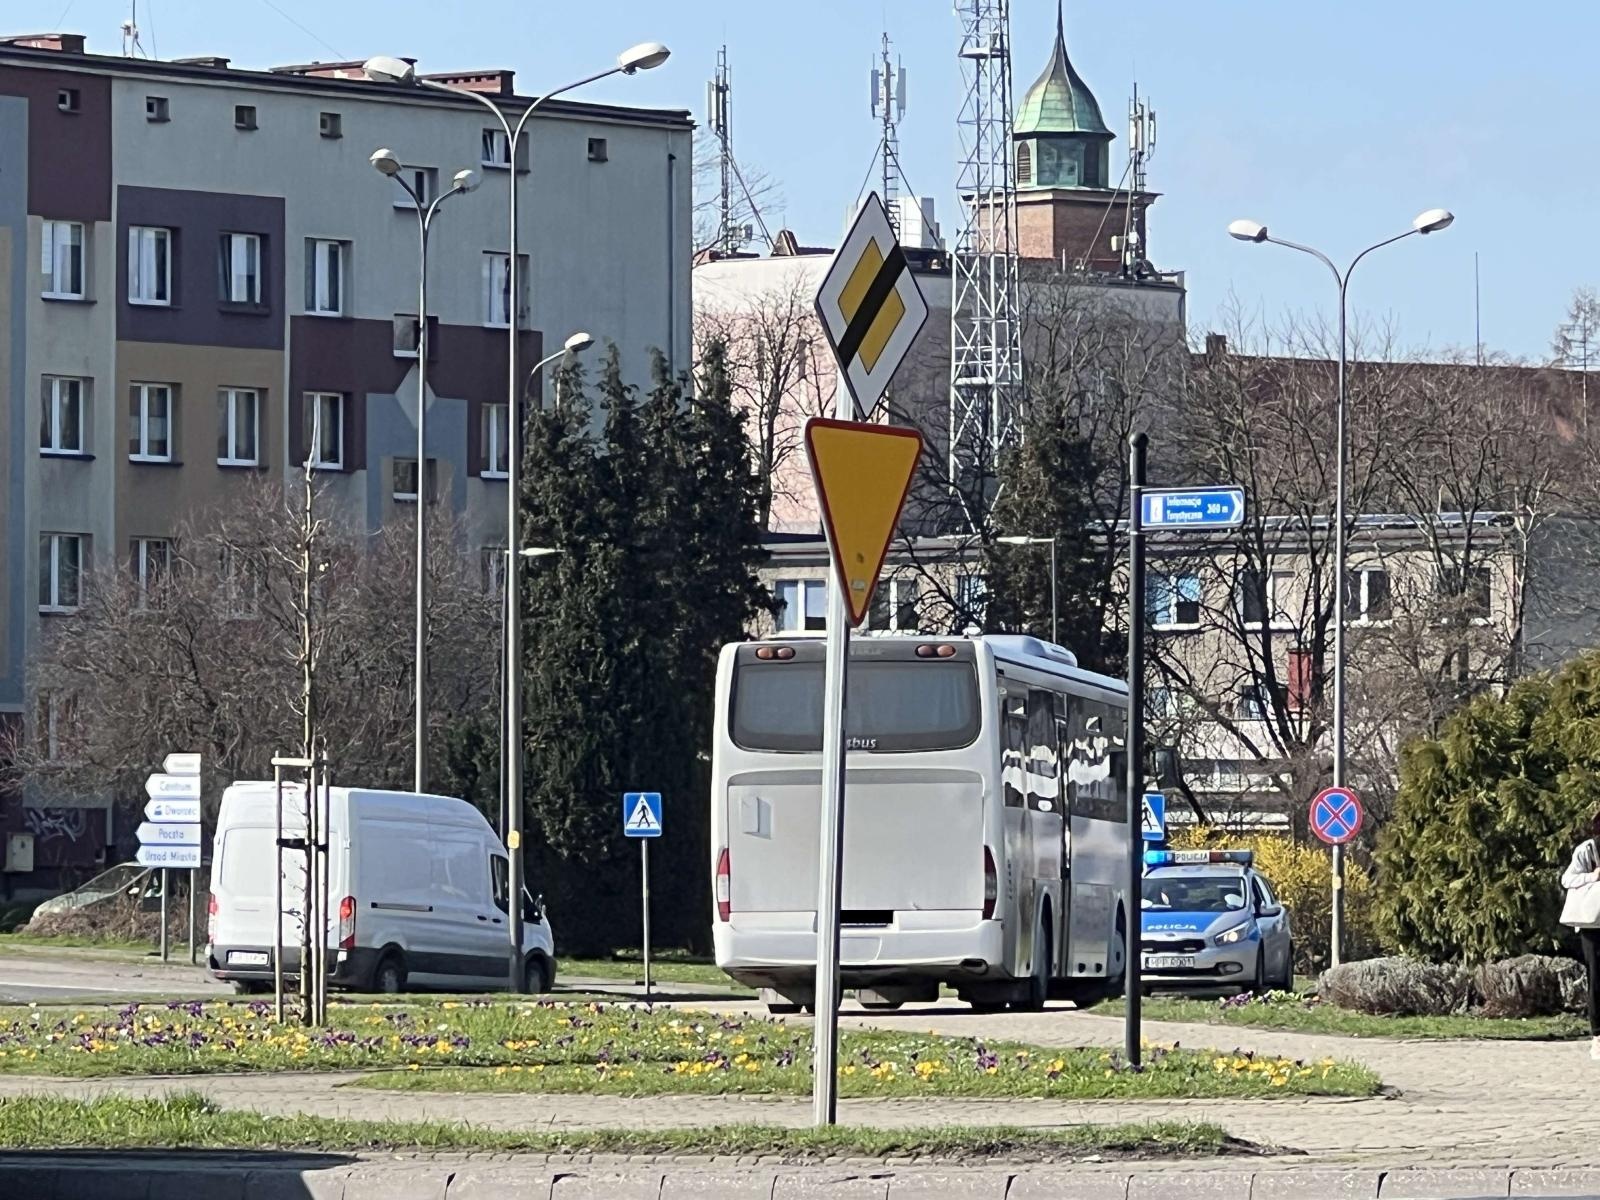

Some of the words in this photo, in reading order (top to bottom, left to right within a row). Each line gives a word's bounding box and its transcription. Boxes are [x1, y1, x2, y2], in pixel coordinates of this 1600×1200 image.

[165, 805, 197, 816] Dworzec
[158, 828, 184, 839] Poczta
[170, 851, 197, 861] Miasta
[1175, 853, 1208, 863] POLICJA
[1147, 923, 1197, 931] POLICJA
